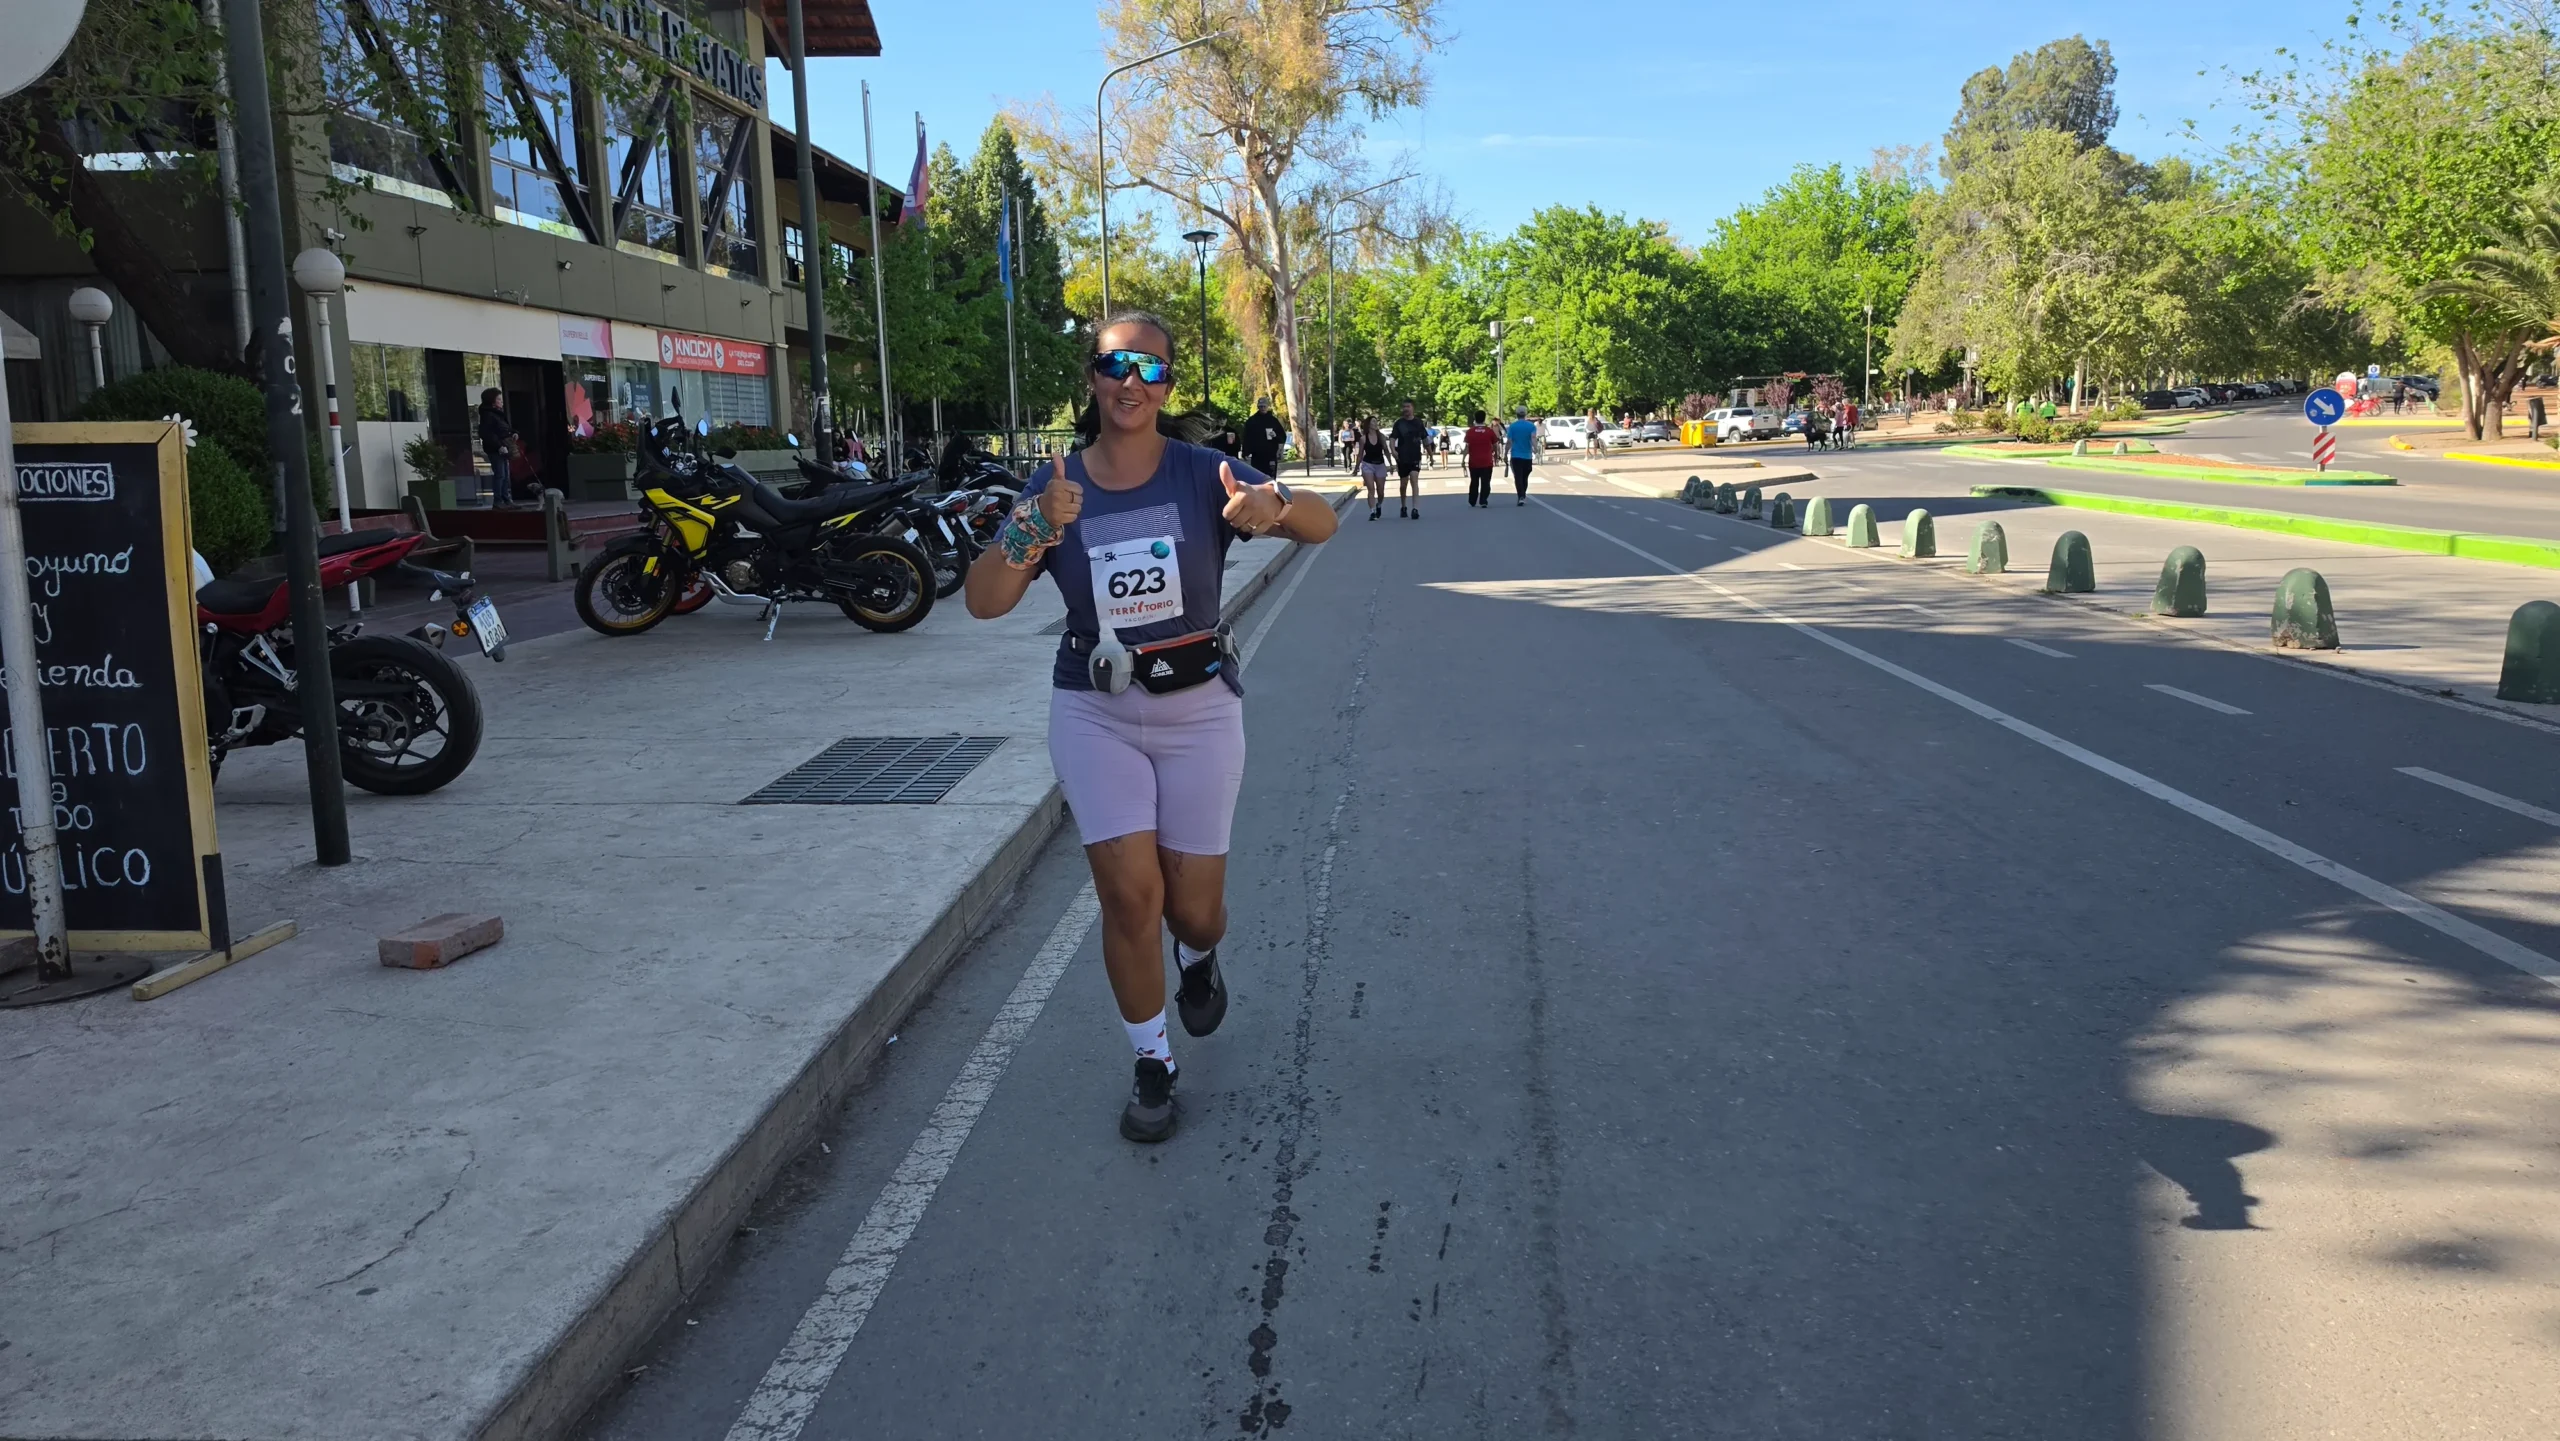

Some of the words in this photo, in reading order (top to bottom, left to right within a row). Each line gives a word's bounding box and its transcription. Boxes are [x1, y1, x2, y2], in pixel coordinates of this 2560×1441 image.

[675, 338, 712, 358] KNOCK
[16, 469, 108, 496] OCIONES
[1105, 551, 1117, 562] 5k
[1108, 566, 1166, 599] 623
[9, 804, 93, 834] TDO
